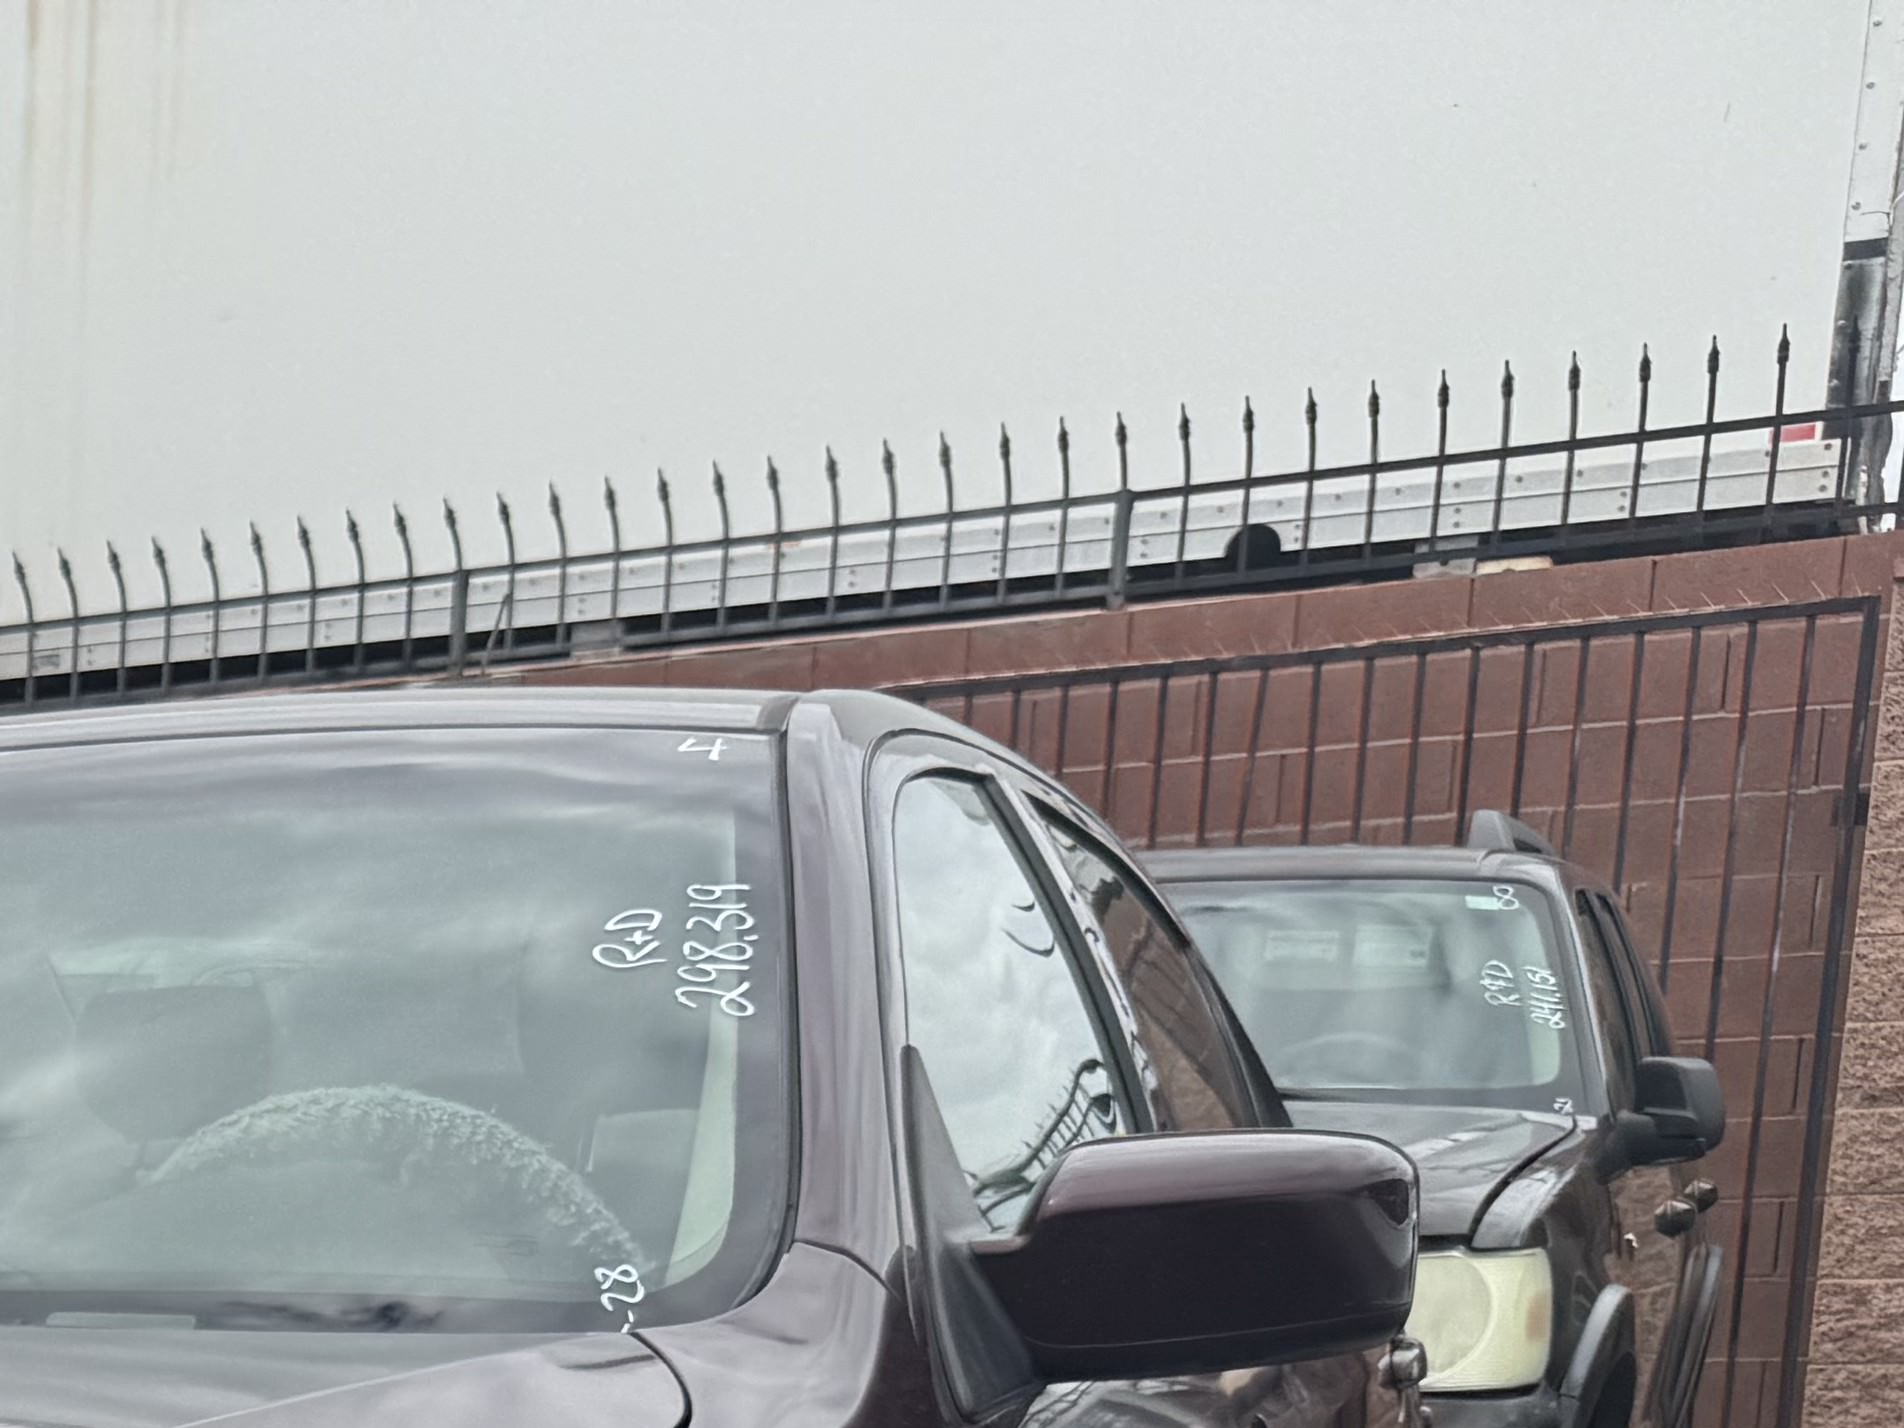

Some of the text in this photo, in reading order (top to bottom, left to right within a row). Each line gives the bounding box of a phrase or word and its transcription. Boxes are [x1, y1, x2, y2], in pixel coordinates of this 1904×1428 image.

[677, 737, 728, 761] 4
[1492, 885, 1520, 911] 8
[592, 909, 668, 968] R+D
[675, 884, 759, 1016] 298,319
